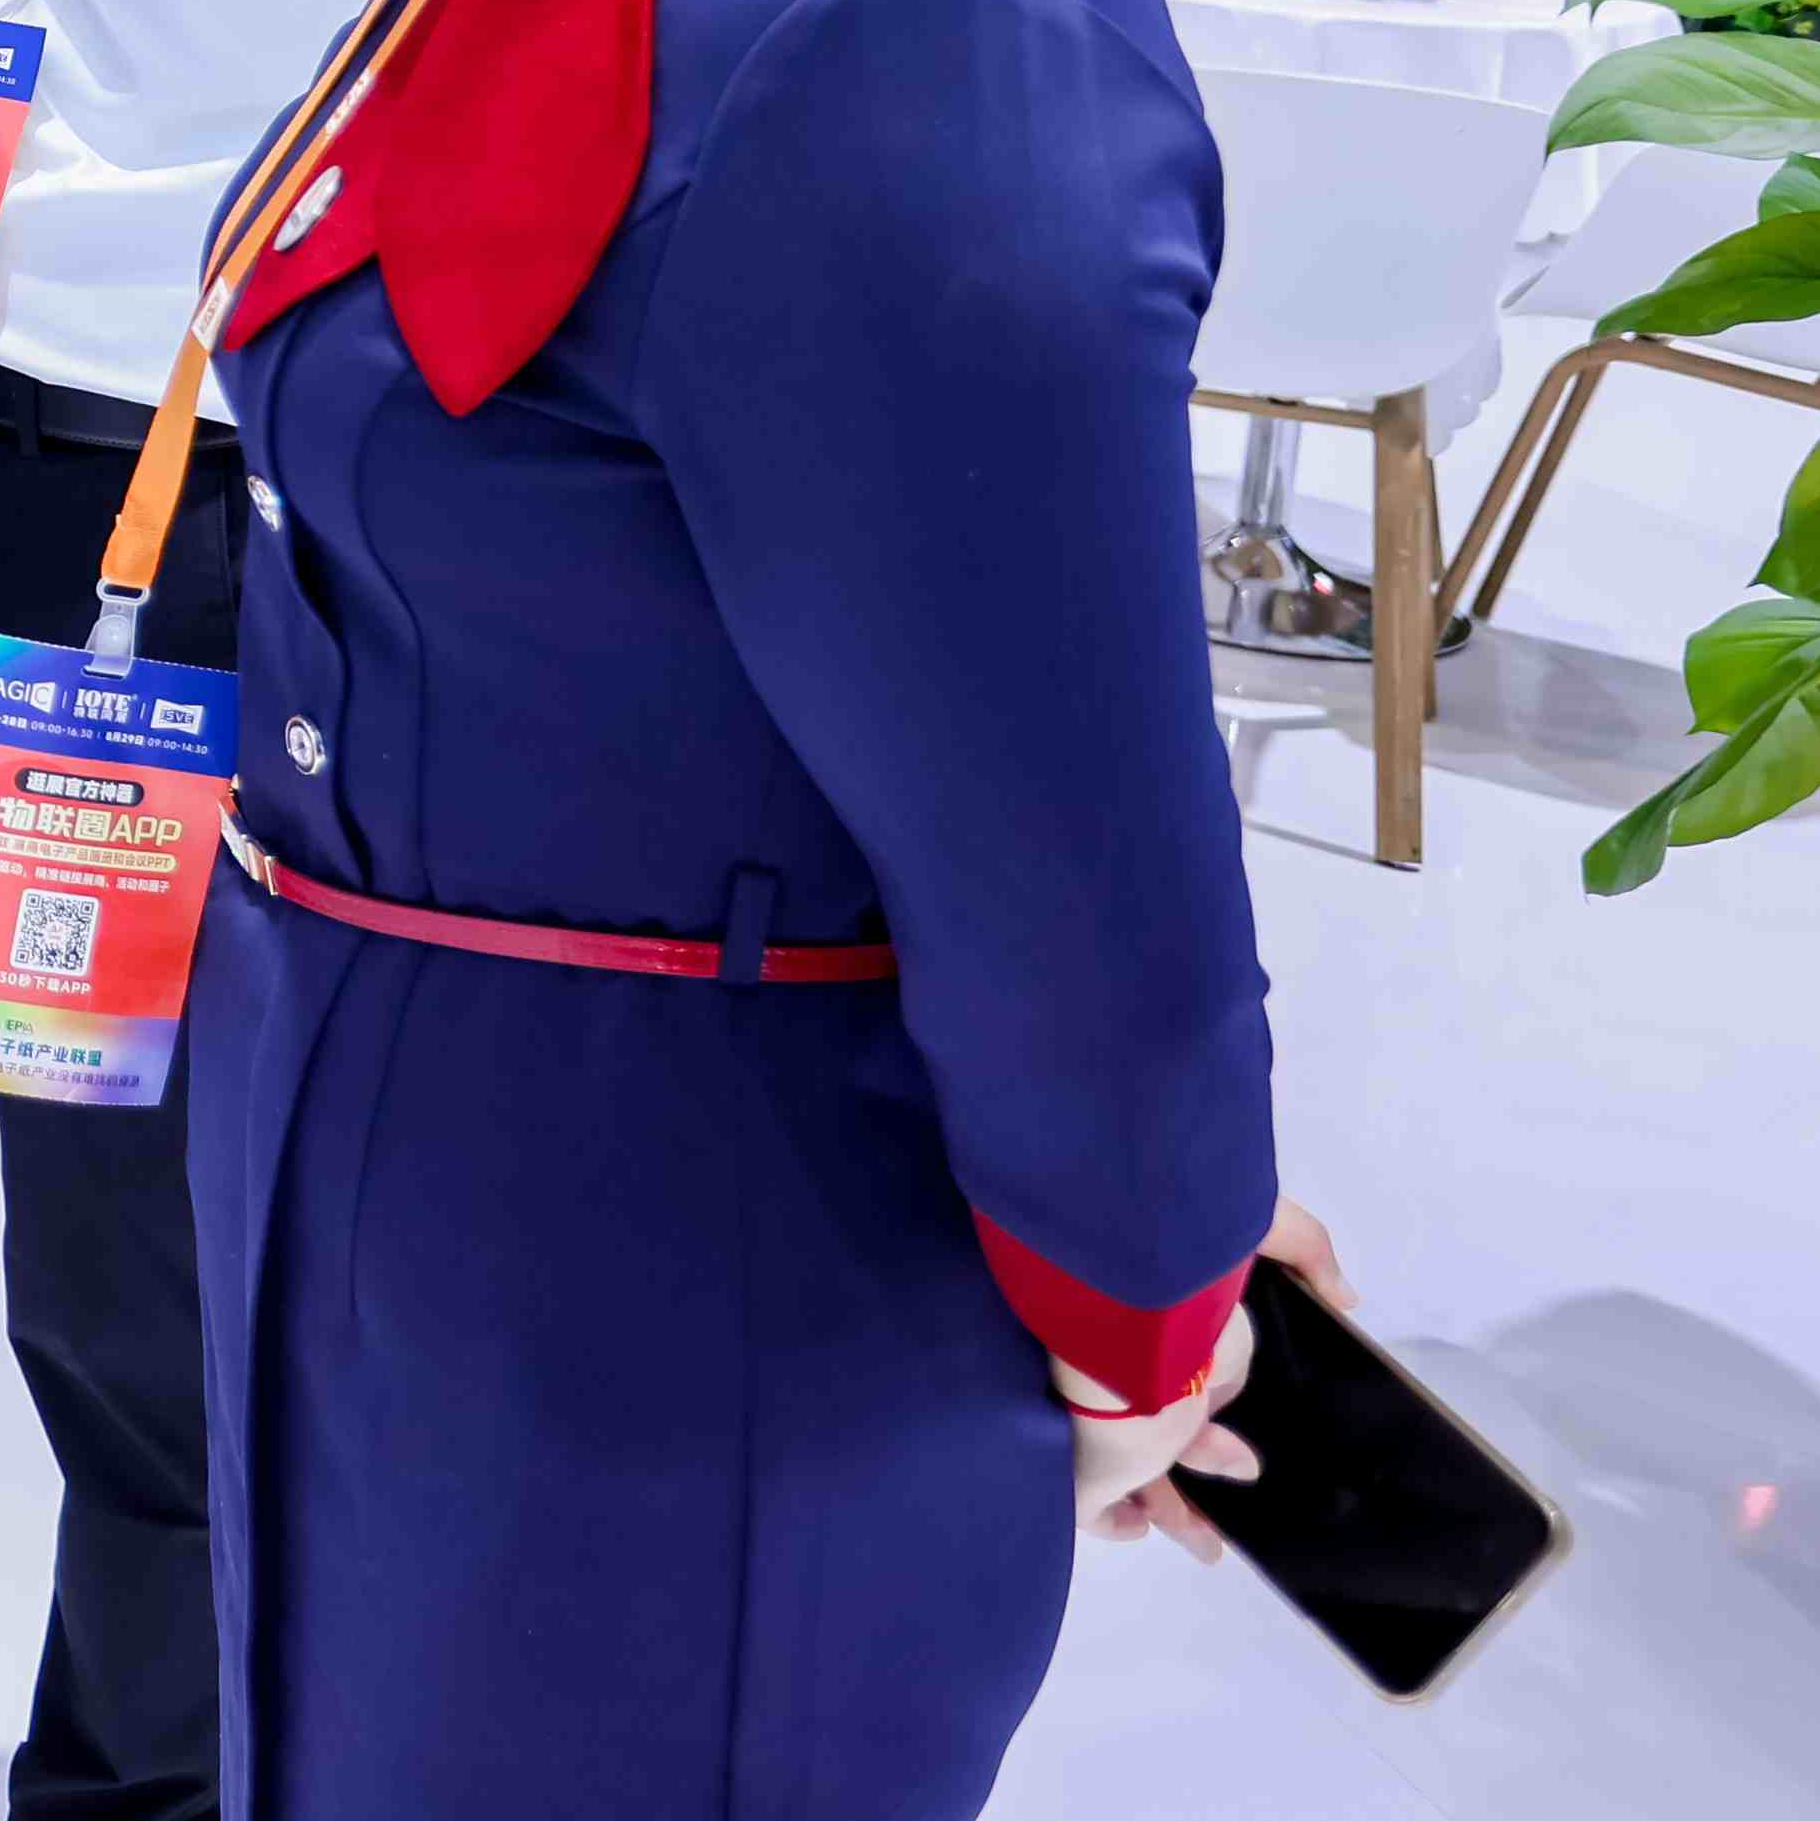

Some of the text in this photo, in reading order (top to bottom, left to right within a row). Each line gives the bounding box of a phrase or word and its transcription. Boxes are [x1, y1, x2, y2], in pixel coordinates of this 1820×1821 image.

[74, 687, 133, 714] IOTE
[26, 771, 133, 805] 逛展官方神器
